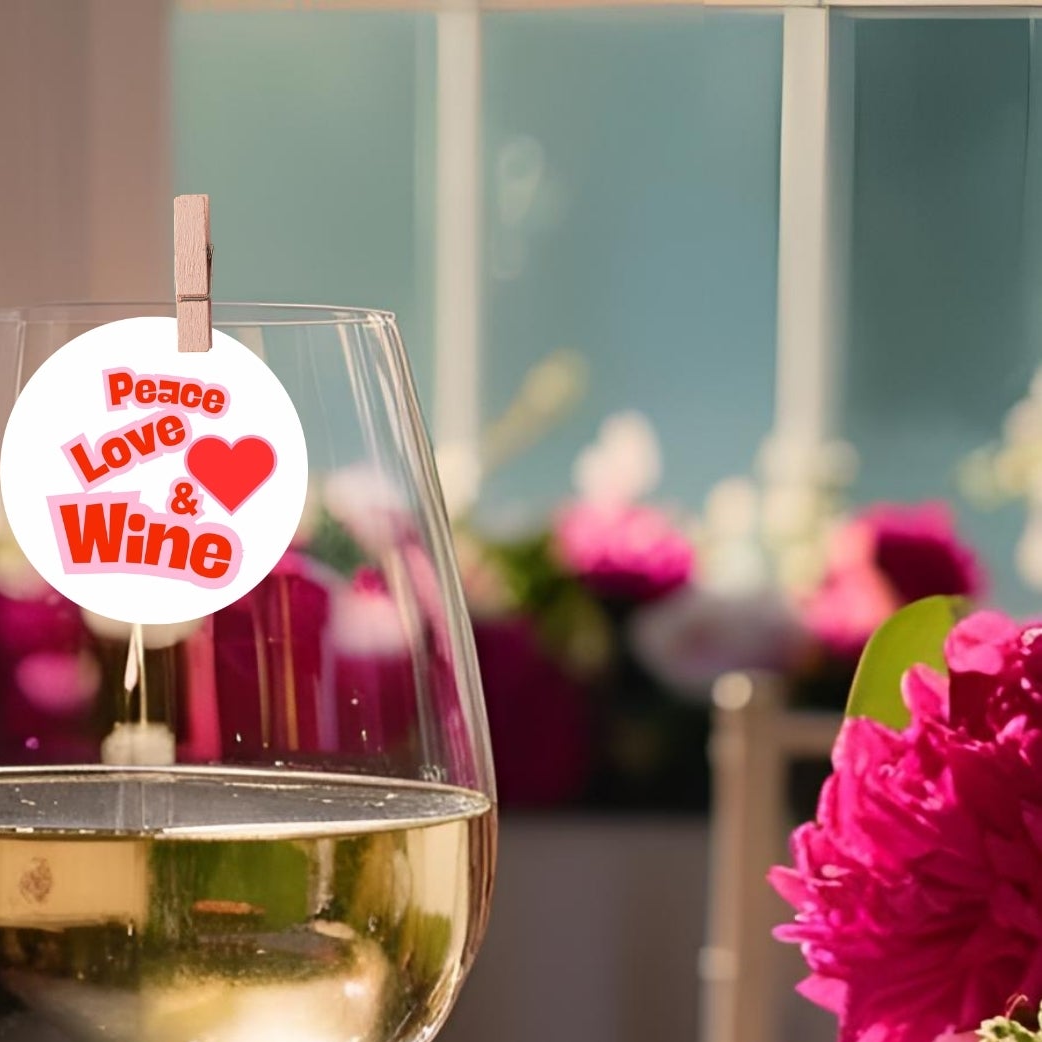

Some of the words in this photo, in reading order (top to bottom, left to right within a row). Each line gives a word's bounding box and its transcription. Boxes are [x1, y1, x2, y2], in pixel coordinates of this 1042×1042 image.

[108, 371, 226, 414] Peace
[69, 414, 187, 483] Love
[169, 481, 199, 517] &
[58, 501, 234, 579] Wine
